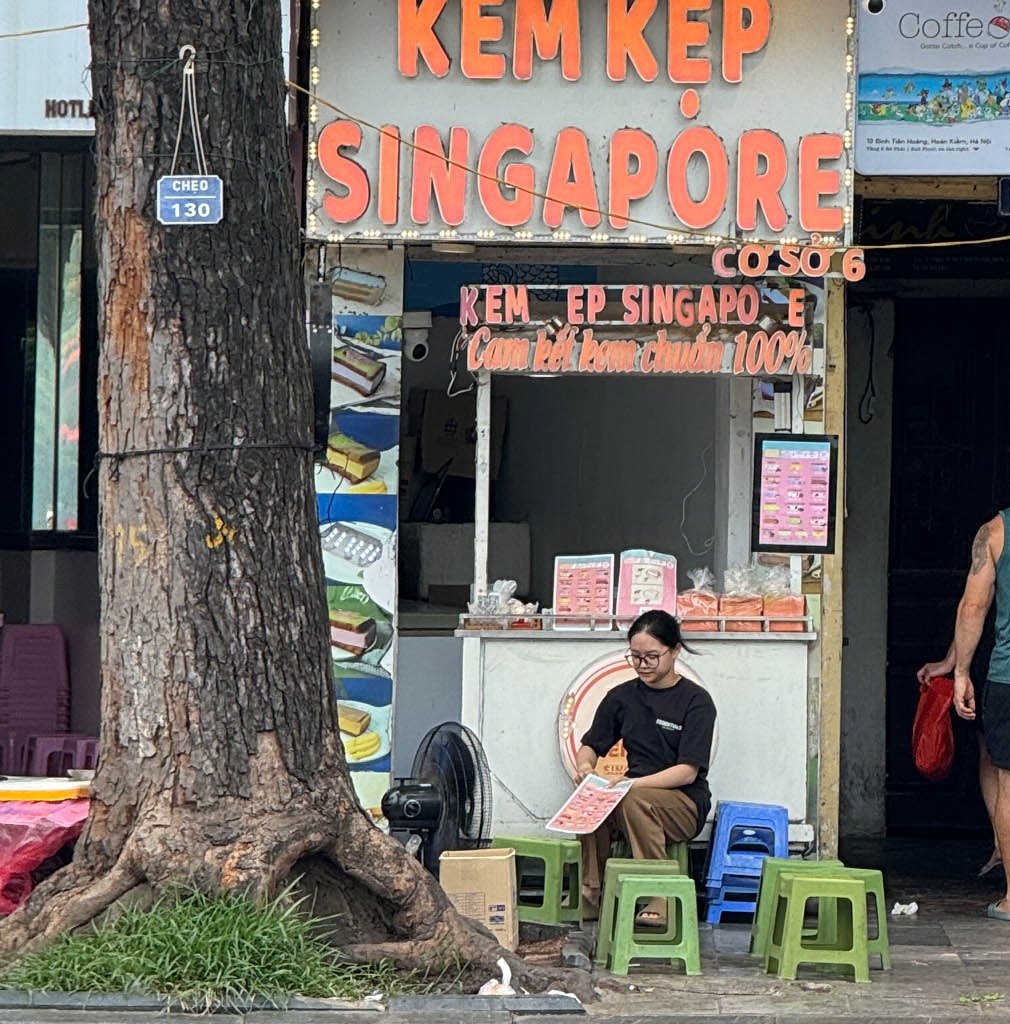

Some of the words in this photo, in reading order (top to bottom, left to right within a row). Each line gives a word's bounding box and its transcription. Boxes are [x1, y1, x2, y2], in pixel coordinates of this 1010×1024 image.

[318, 120, 845, 233] SINGAPORE
[171, 203, 210, 217] 130
[842, 249, 867, 281] 6
[459, 285, 531, 327] KEM
[567, 284, 607, 325] EP
[467, 326, 531, 372] Cam
[578, 328, 638, 373] kem
[734, 329, 813, 375] 100%
